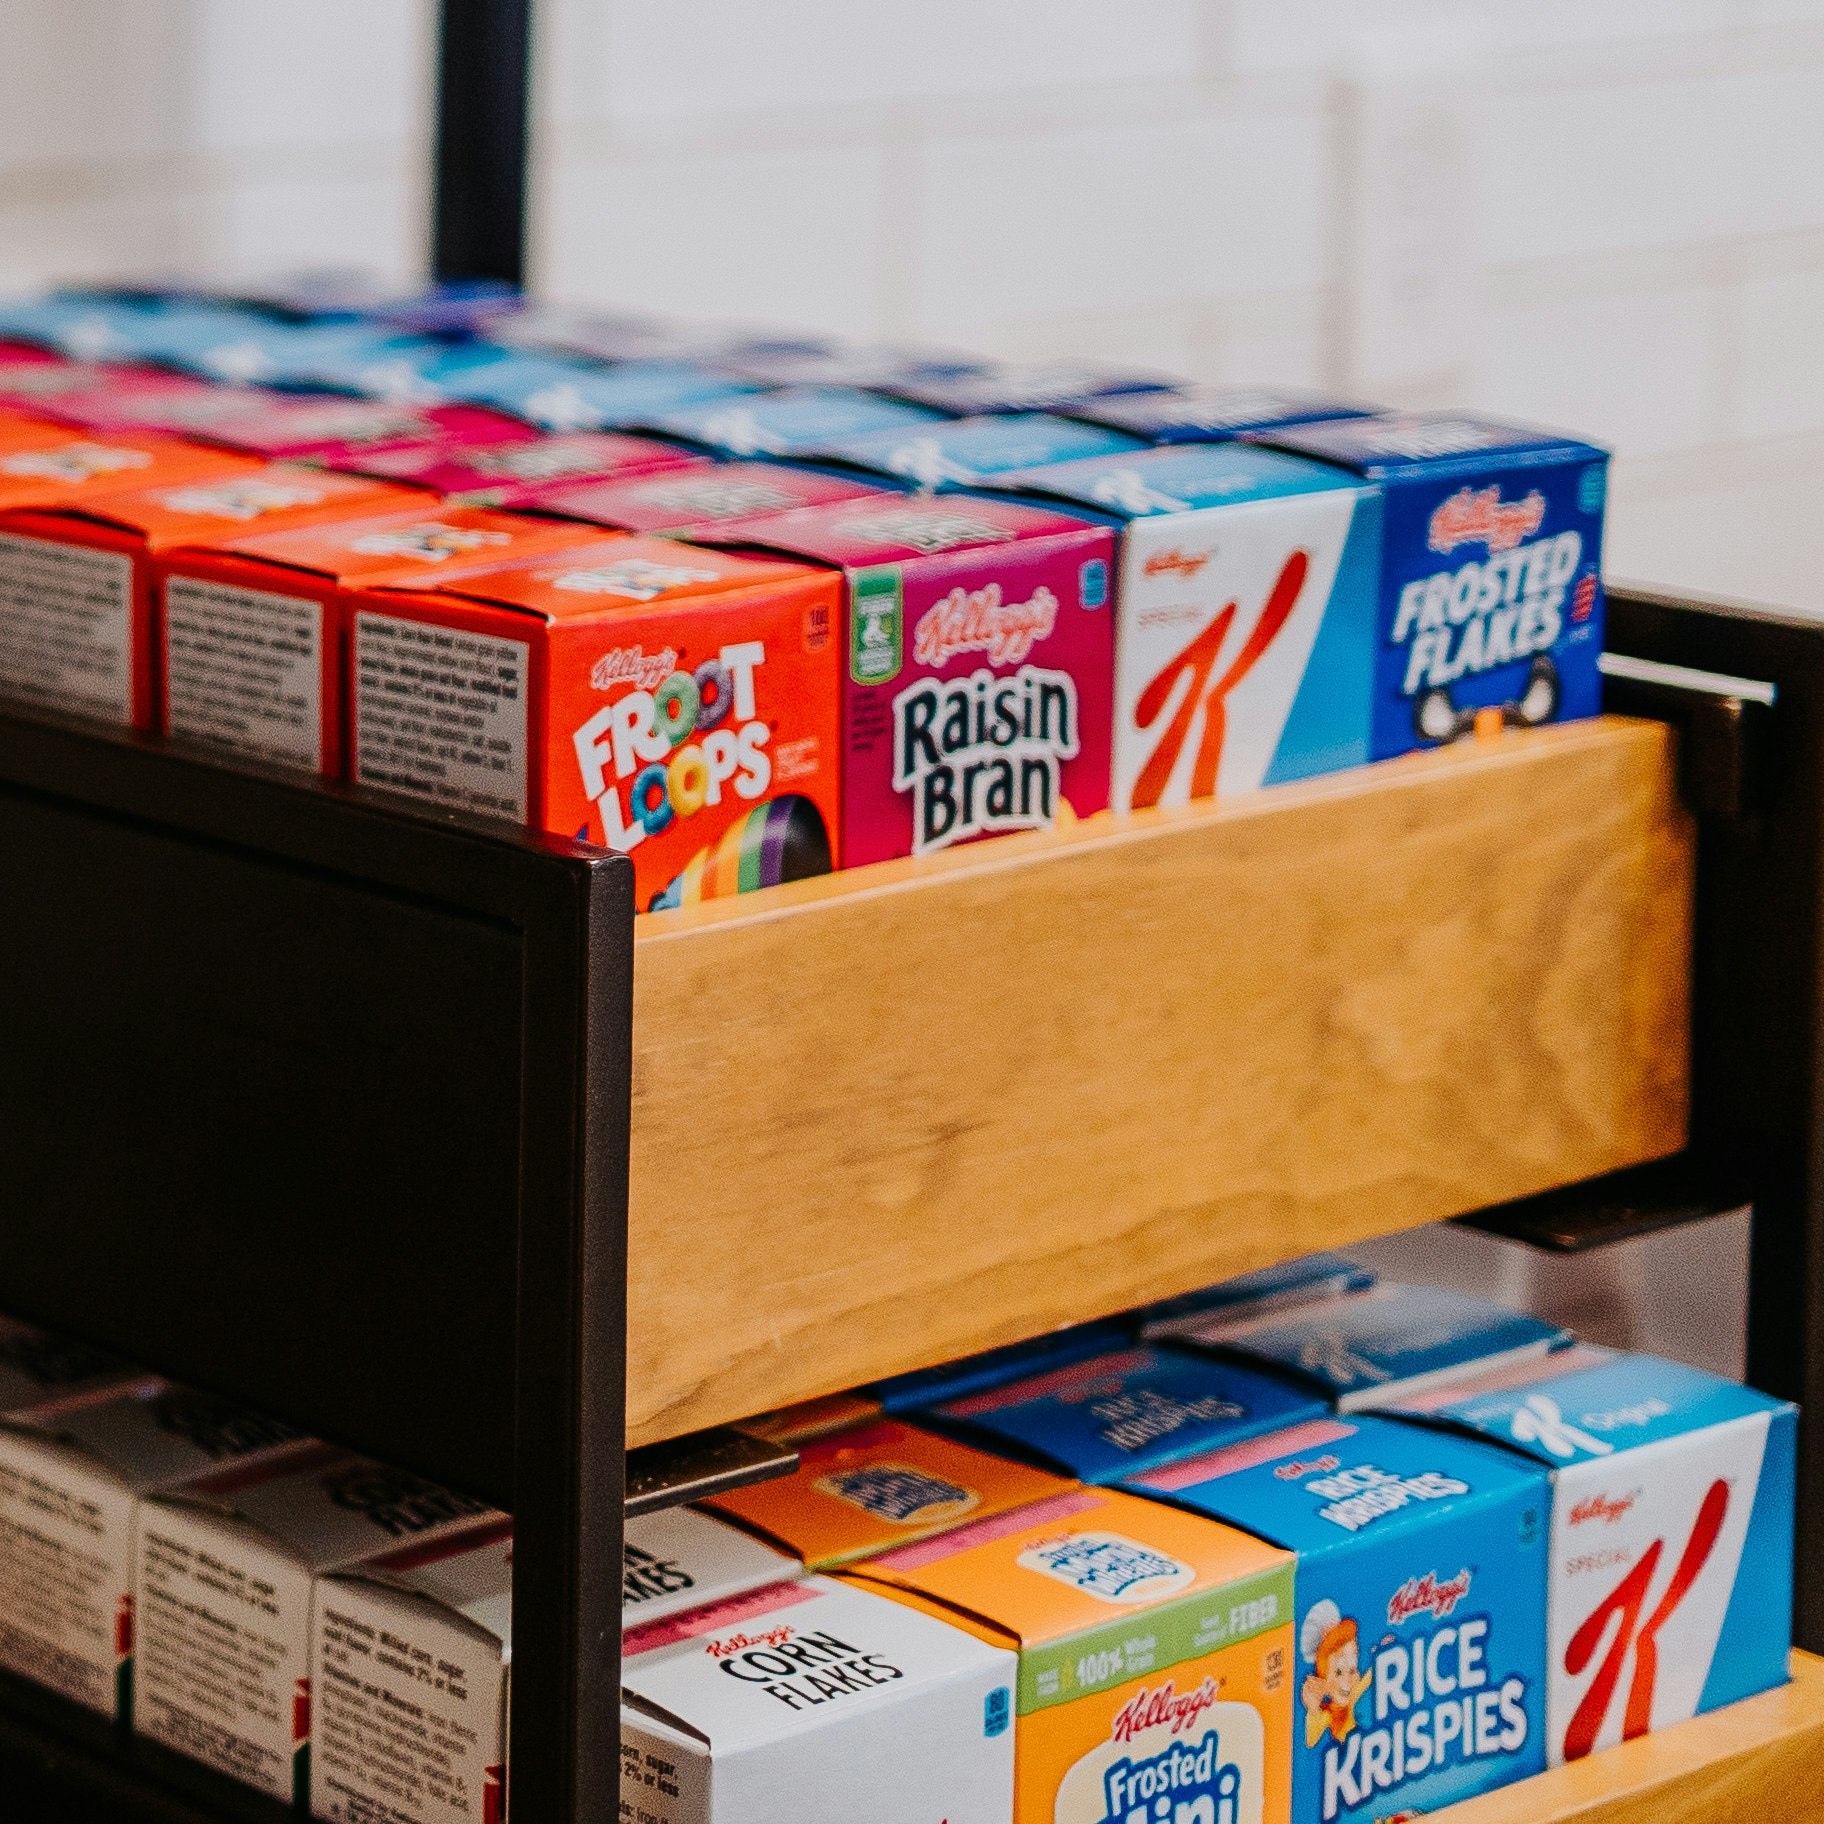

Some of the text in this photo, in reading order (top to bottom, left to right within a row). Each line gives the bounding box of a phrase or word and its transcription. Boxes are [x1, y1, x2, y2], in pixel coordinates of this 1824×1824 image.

[914, 583, 1059, 668] Kellogg's
[1391, 530, 1582, 643] FROSTED
[1132, 548, 1309, 810] K
[1402, 585, 1566, 695] FLAKES
[573, 641, 765, 801] FROOT
[900, 676, 1072, 780] Raisin
[597, 721, 771, 852] LOOPS
[922, 757, 1053, 846] Bran
[705, 1624, 797, 1658] Kellogg's
[1229, 1594, 1278, 1635] FIBER
[1387, 1568, 1472, 1626] Kellogg's
[1564, 1477, 1730, 1762] K
[719, 1630, 863, 1684] CORN
[761, 1653, 905, 1712] FLAKES
[1076, 1647, 1124, 1688] 100%
[1375, 1619, 1487, 1721] RICE
[1113, 1676, 1218, 1743] Kellogg's
[1323, 1679, 1528, 1821] KRISPIES
[1109, 1736, 1215, 1817] Frosted
